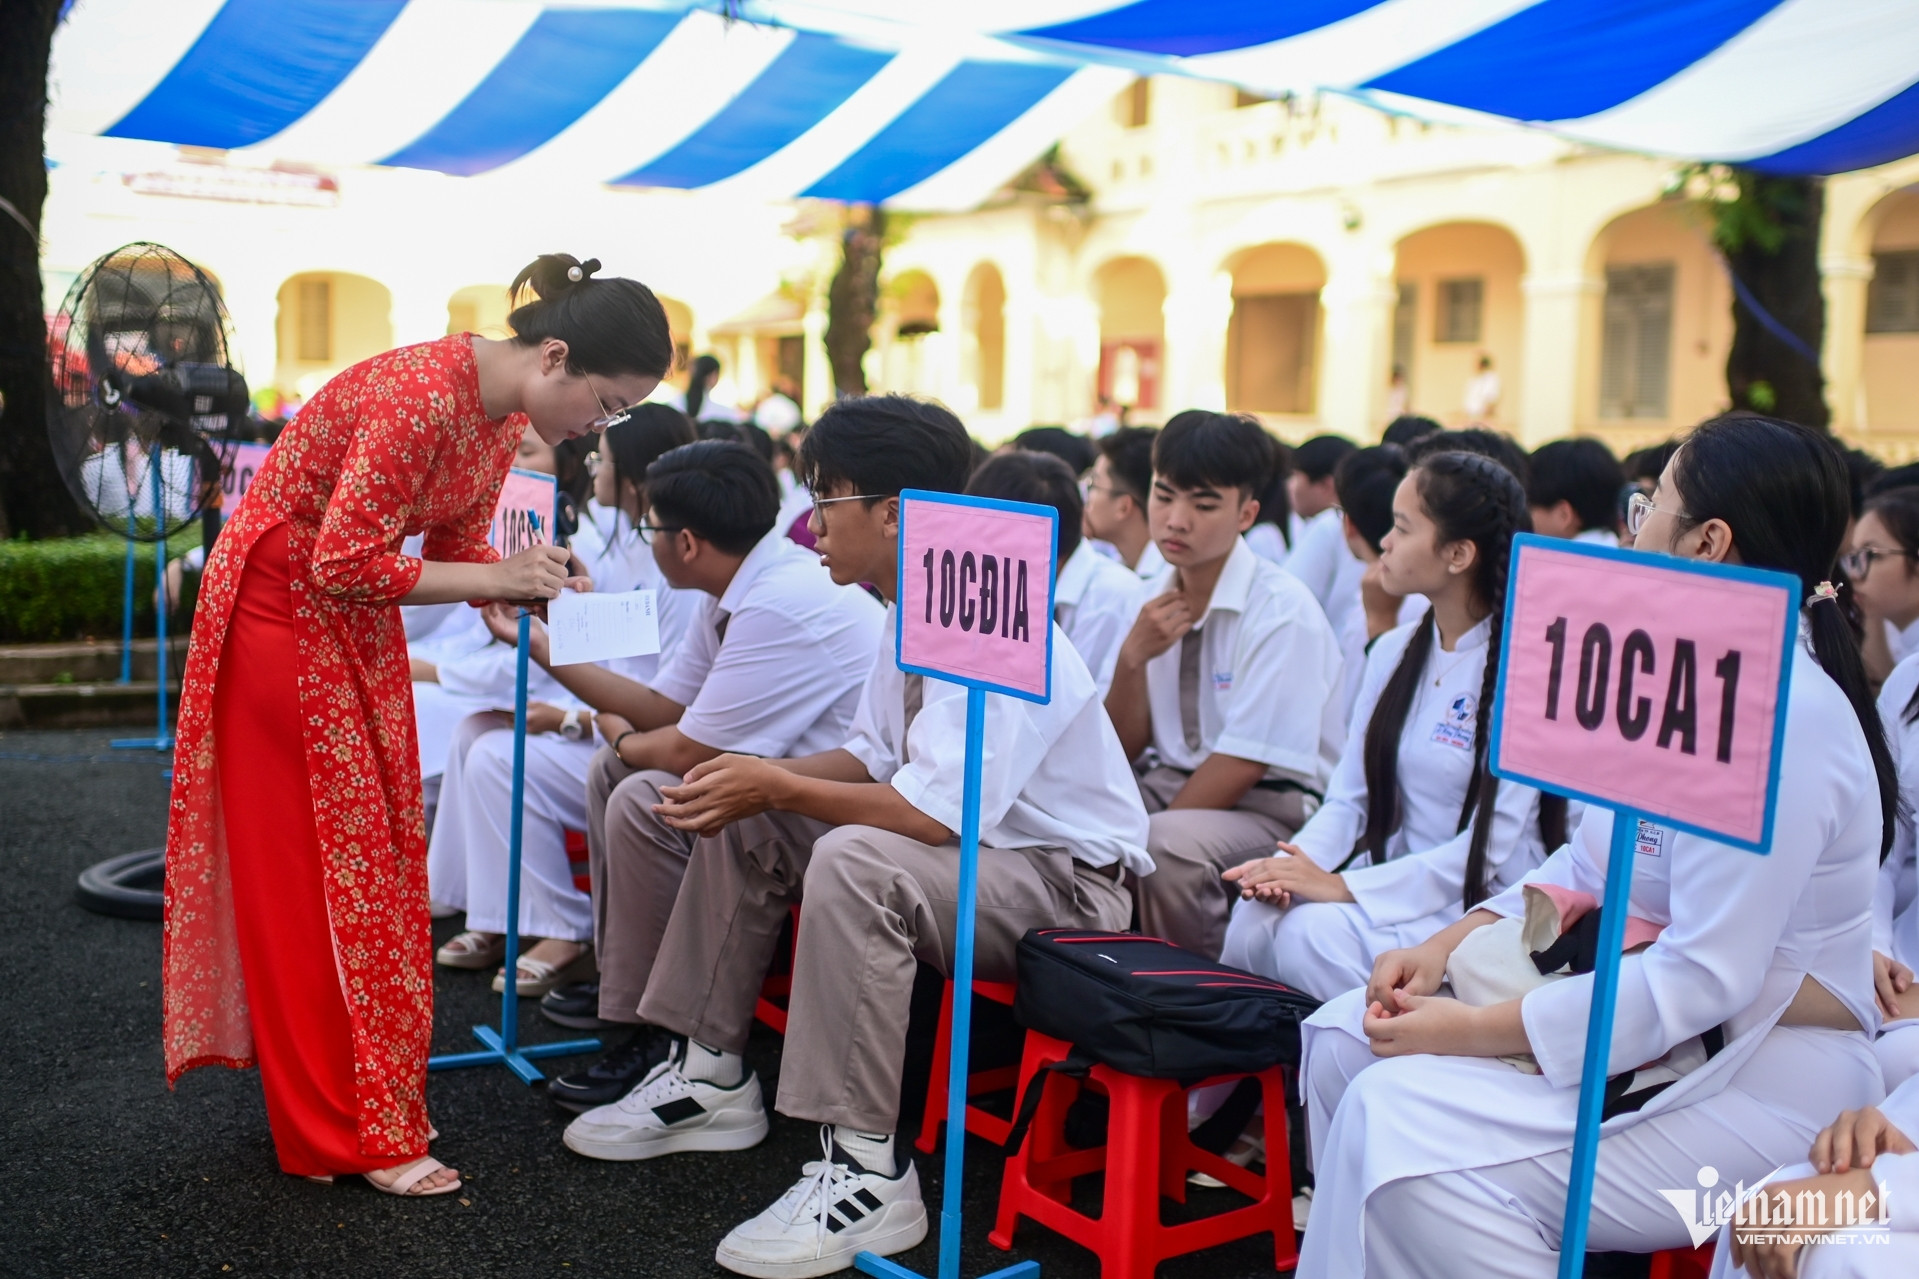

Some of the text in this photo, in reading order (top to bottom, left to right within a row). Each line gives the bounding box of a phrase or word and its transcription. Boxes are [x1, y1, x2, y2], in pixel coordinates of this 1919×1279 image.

[923, 548, 1029, 643] 10CĐIA
[1544, 616, 1742, 765] 10CA1
[1640, 845, 1655, 854] 10CA1
